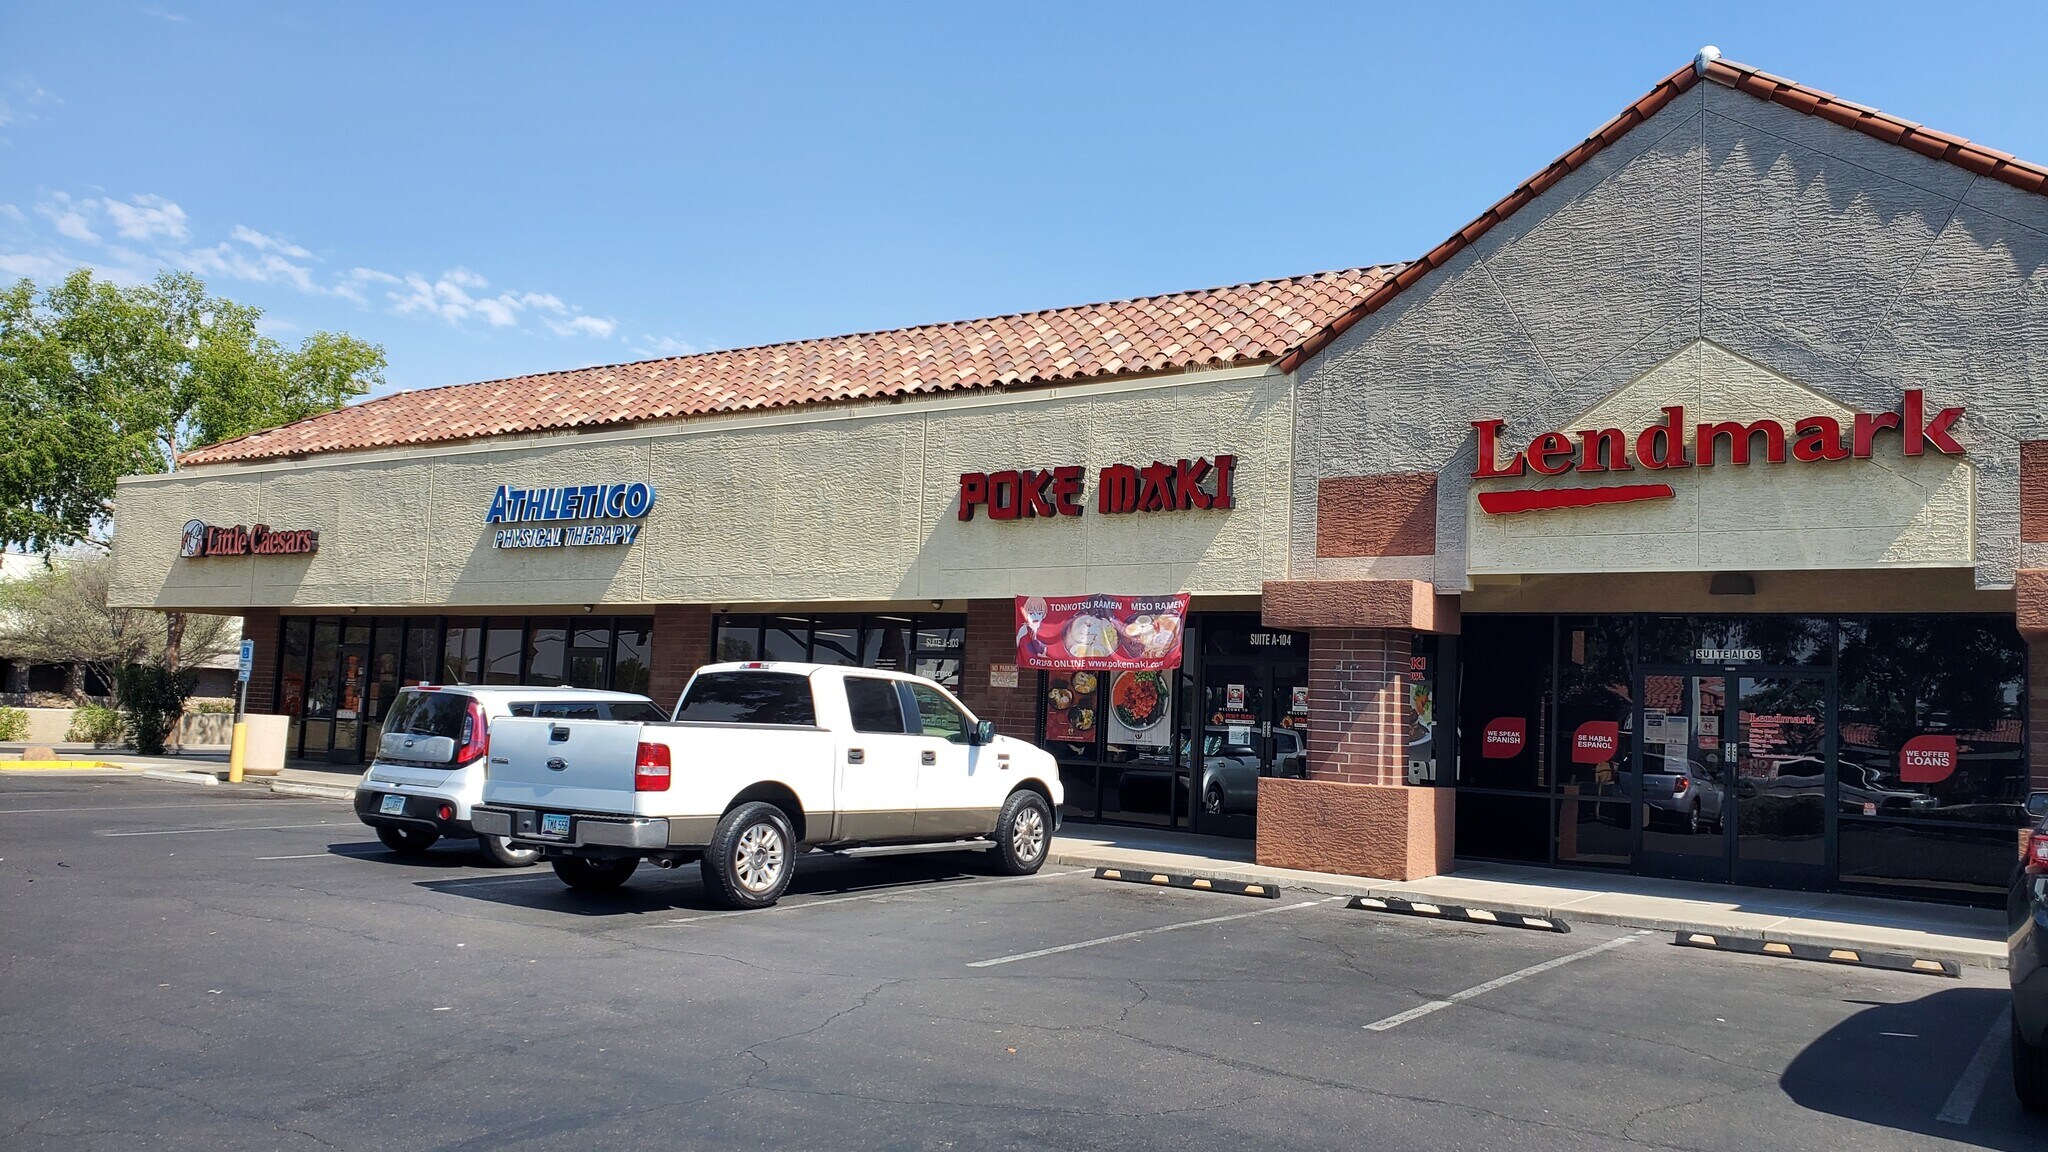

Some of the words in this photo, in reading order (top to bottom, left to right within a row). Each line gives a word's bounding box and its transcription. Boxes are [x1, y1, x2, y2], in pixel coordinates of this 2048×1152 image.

[1470, 389, 1967, 480] Lendmark
[958, 465, 1085, 522] POKE
[1099, 454, 1237, 514] MAKI
[485, 482, 655, 524] ATHLETICO
[205, 524, 247, 555] Little
[250, 523, 315, 555] Caesars
[493, 527, 563, 549] PHYSICAL
[564, 524, 638, 548] THERAPY
[1050, 601, 1092, 611] TONKOTSU
[1093, 600, 1122, 610] RAMEN
[1131, 602, 1153, 611] MISO
[1154, 600, 1186, 611] RAMEN
[1250, 633, 1270, 646] SUITE
[1271, 633, 1291, 646] A-104
[1054, 659, 1086, 668] ONLINE
[1487, 736, 1520, 744] SPANISH
[1921, 750, 1950, 758] OFFER
[1907, 756, 1950, 767] LOANS
